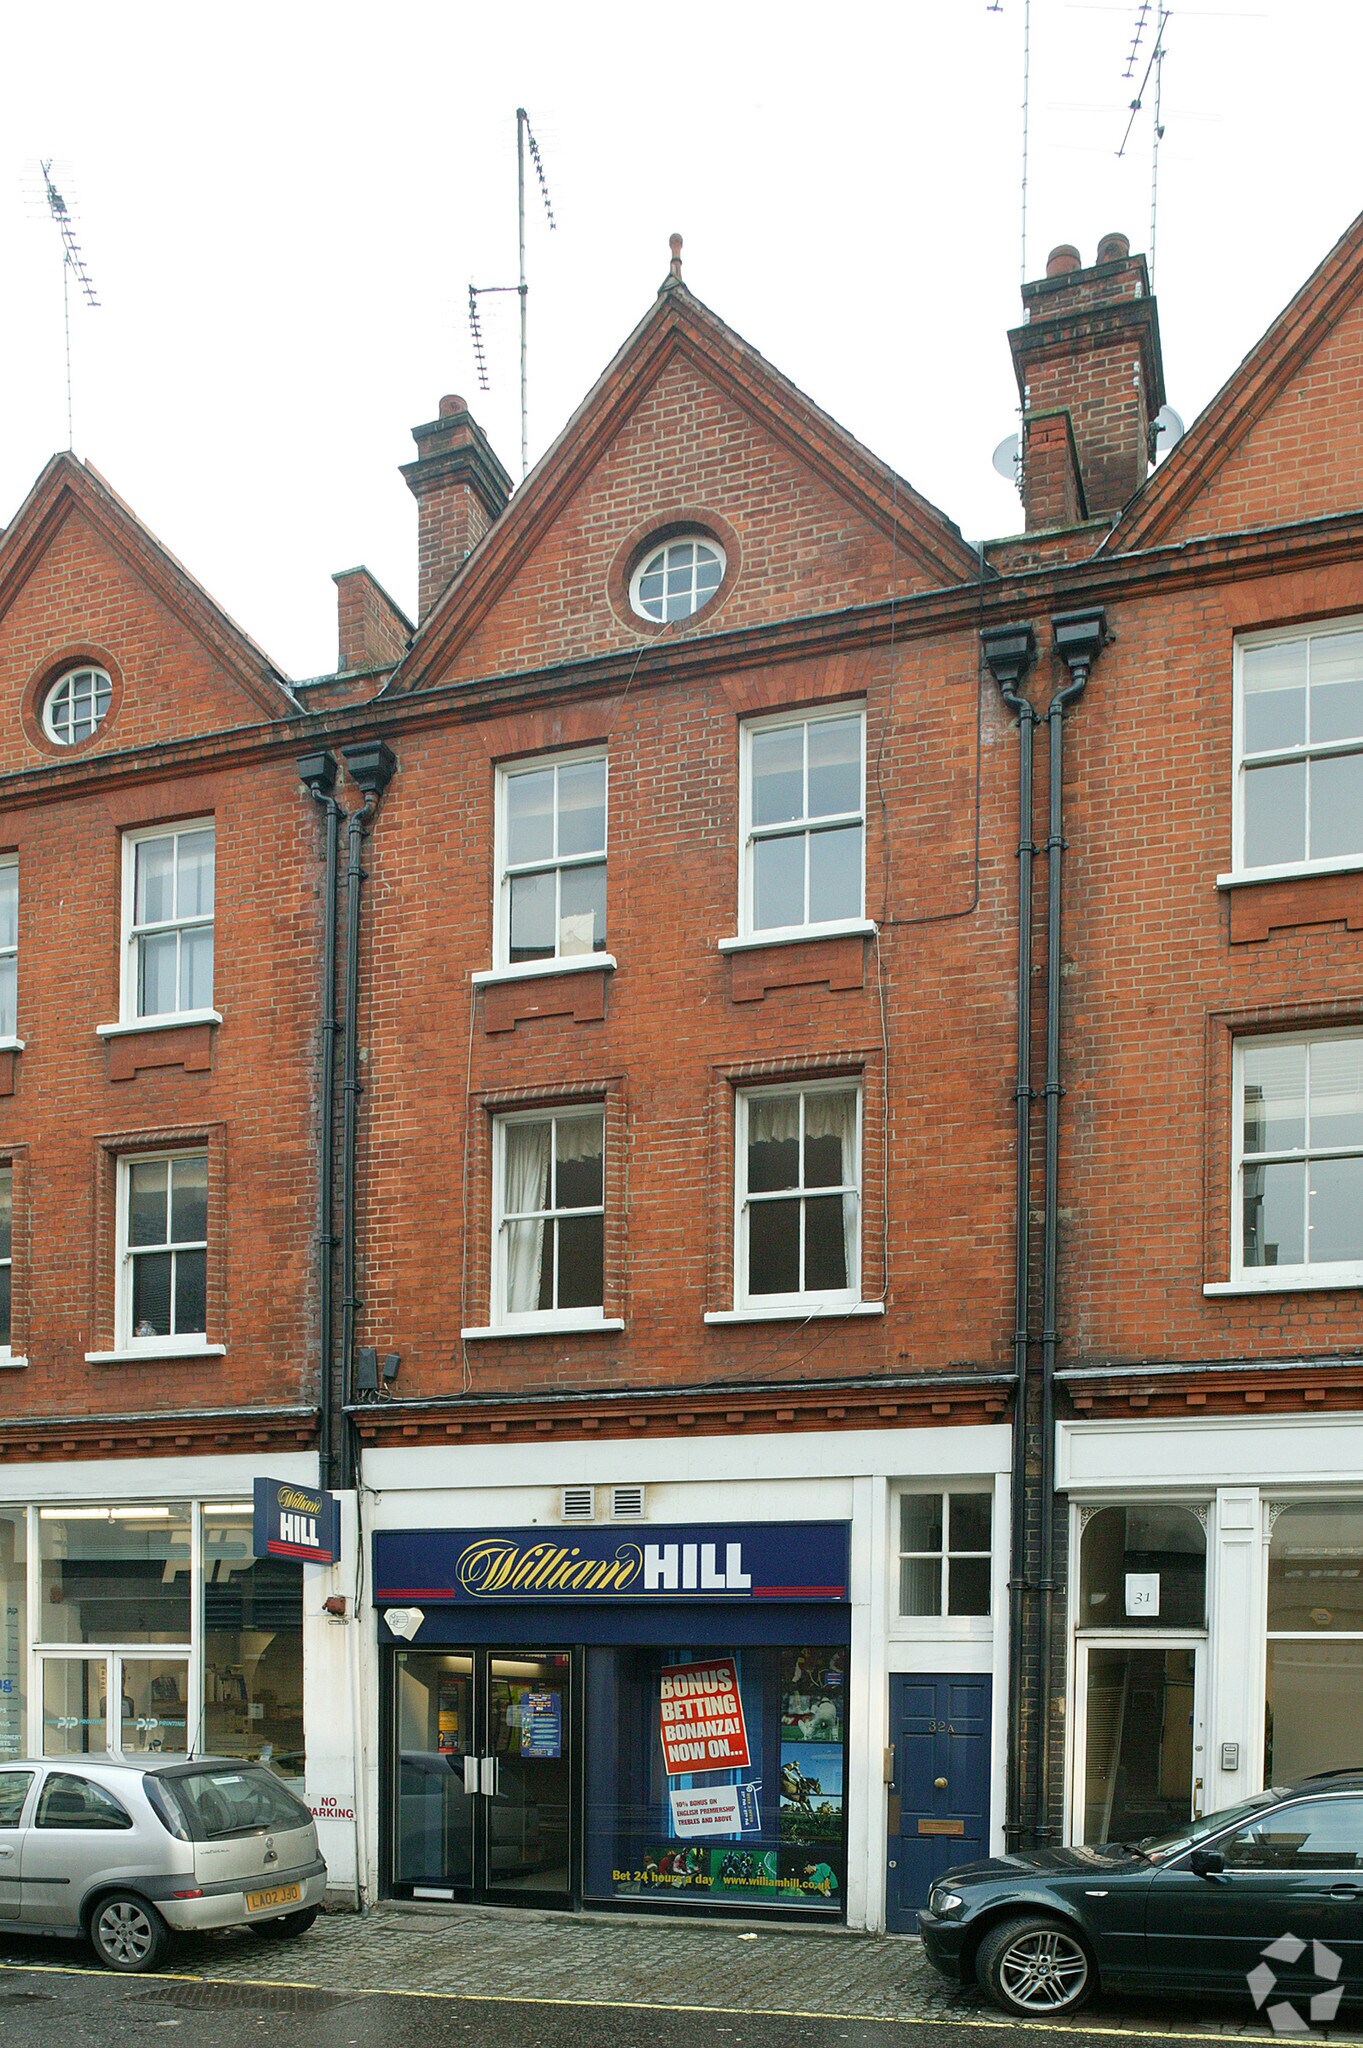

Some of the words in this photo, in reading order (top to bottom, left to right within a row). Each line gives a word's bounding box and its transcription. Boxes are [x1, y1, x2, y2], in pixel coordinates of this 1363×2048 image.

[277, 1485, 322, 1515] William
[280, 1512, 319, 1547] HILL
[455, 1538, 643, 1594] William
[643, 1542, 751, 1590] HILL
[1134, 1591, 1150, 1605] 31
[660, 1668, 733, 1700] BONUS
[661, 1693, 737, 1722] BETTING
[665, 1717, 740, 1742] BONANZA!
[928, 1720, 955, 1733] 32A
[668, 1740, 706, 1763] NOW
[707, 1738, 743, 1759] ON...
[321, 1797, 337, 1807] NO
[689, 1799, 708, 1807] BONUS
[677, 1808, 699, 1817] ENGLISH
[700, 1805, 736, 1815] PREMIERSHIP
[701, 1816, 713, 1824] AND
[714, 1815, 732, 1823] ABOVE
[612, 1870, 631, 1881] Bet
[634, 1871, 648, 1882] 24
[651, 1873, 682, 1885] hours
[685, 1876, 692, 1884] a
[695, 1874, 714, 1886] day
[723, 1874, 832, 1890] www.williamhill.co.uk
[252, 1892, 278, 1908] LA02
